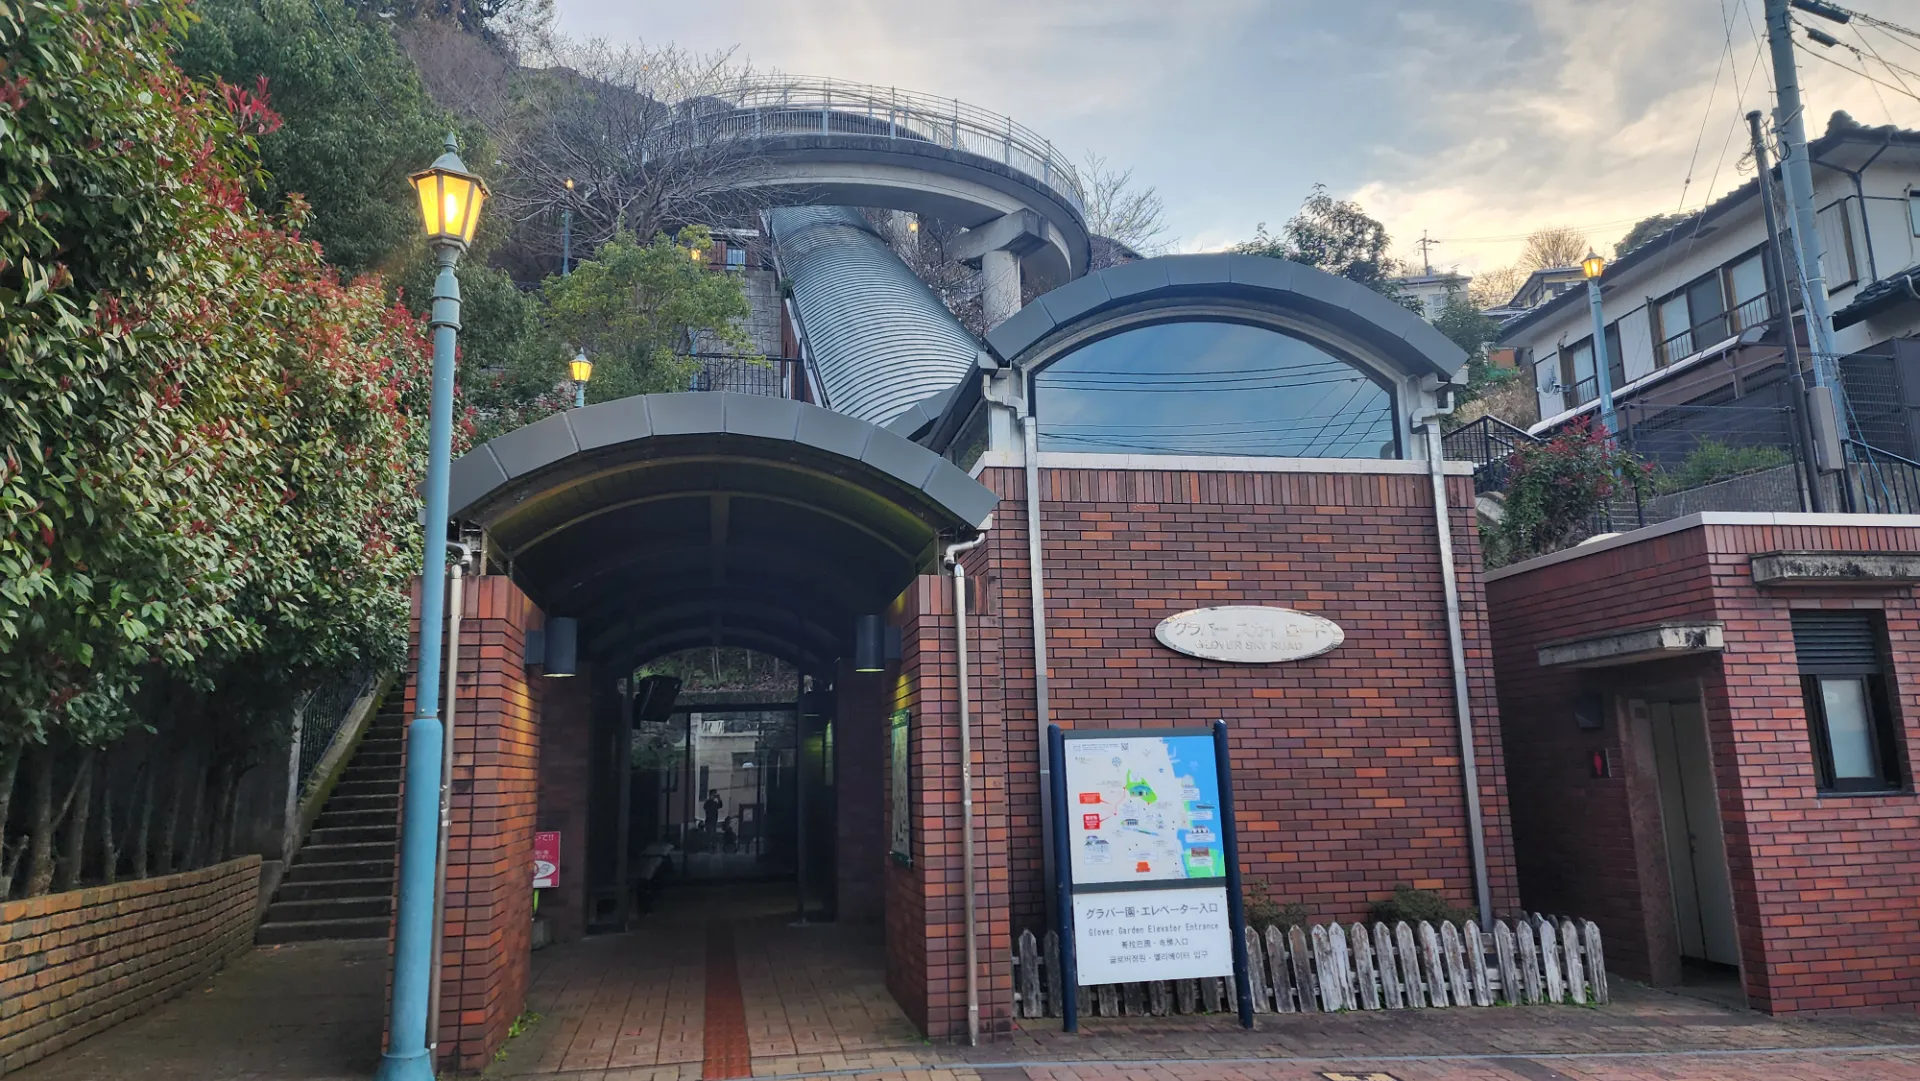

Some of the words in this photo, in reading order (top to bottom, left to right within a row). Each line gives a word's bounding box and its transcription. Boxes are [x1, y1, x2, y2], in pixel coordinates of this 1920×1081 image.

[1088, 927, 1114, 937] Glover
[1118, 925, 1144, 935] Garden
[1147, 923, 1181, 933] Elevator
[1185, 922, 1219, 931] Entrance
